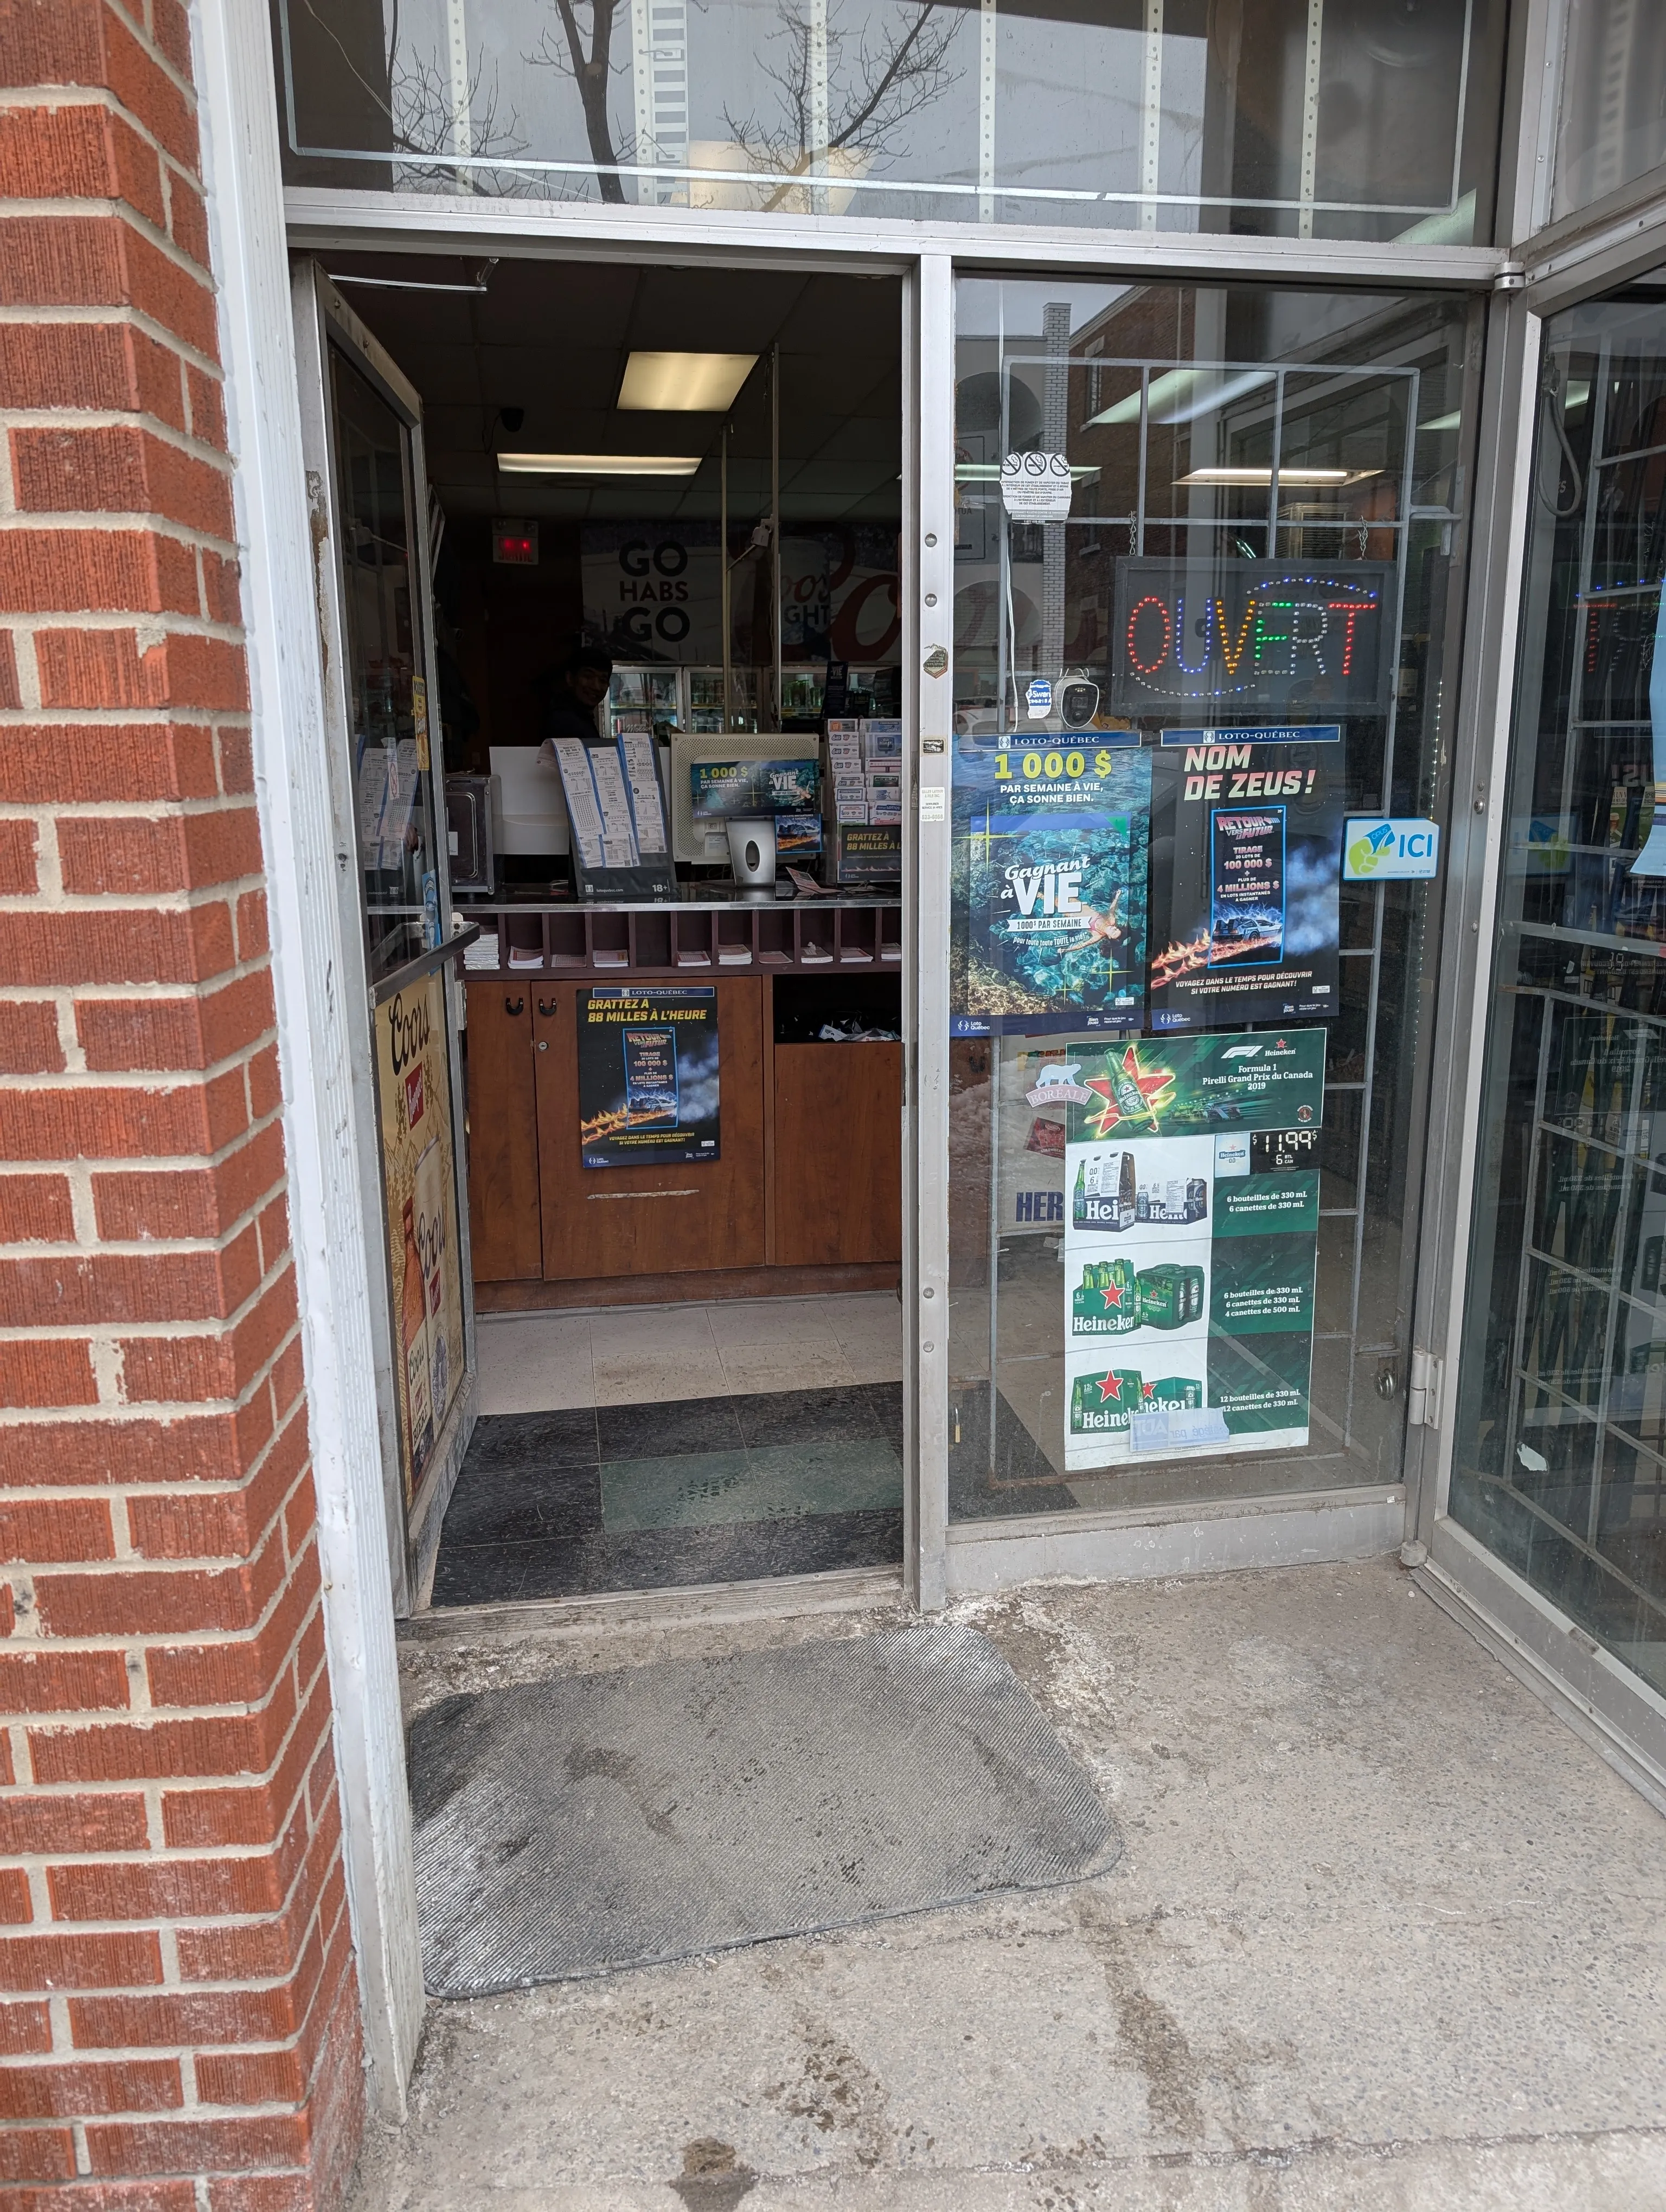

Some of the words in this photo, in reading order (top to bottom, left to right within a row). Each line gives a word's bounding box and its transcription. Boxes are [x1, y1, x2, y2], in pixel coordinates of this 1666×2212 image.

[619, 541, 688, 576] GO
[620, 581, 688, 601] HABS
[622, 607, 690, 642] GO
[1127, 596, 1377, 676] OUVERT
[1015, 736, 1099, 745] LOTO-QUÉBEC
[1219, 731, 1300, 740] LOTO-QUÉBEC
[995, 754, 1013, 779] 1
[1022, 751, 1085, 779] 000
[1094, 750, 1111, 779] $
[1184, 745, 1252, 771] NOM
[700, 768, 707, 779] 1
[712, 767, 736, 778] 000
[741, 766, 748, 777] $
[772, 775, 797, 790] VIE
[1001, 785, 1021, 793] PAR
[1023, 783, 1074, 793] SEMAINE
[1075, 781, 1082, 792] À
[1084, 782, 1104, 792] VIE,
[1184, 775, 1223, 800] DE
[1010, 796, 1026, 805] ÇA
[1027, 795, 1065, 803] SONNE
[1066, 794, 1094, 802] BIEN.
[1216, 816, 1266, 831] RETOUR
[883, 831, 889, 840] À
[1372, 826, 1388, 839] OPUS
[1233, 846, 1263, 854] TIRAGE
[1399, 834, 1432, 858] ICI
[1005, 856, 1090, 880] Gagnant
[1224, 860, 1241, 869] 100
[1244, 859, 1263, 868] 000
[1265, 858, 1272, 867] $
[1225, 882, 1270, 892] MILLIONS
[1273, 880, 1279, 889] $
[1001, 885, 1014, 899] à
[1013, 872, 1081, 915] VIE
[1053, 919, 1081, 928] SEMAINE
[1176, 979, 1204, 988] VOYAGEZ
[1277, 970, 1312, 980] DÉCOUVRIR
[1221, 983, 1249, 993] NUMÉRO
[588, 999, 639, 1009] GRATTEZ
[640, 997, 649, 1008] À
[588, 1012, 603, 1023] 88
[606, 1011, 648, 1021] MILLES
[650, 1008, 658, 1021] À
[661, 1009, 707, 1020] L'HEURE
[389, 992, 430, 1076] Coors
[1228, 1075, 1252, 1083] Grand
[1248, 1082, 1266, 1090] 2019
[1030, 1087, 1089, 1106] BORÉALE
[1276, 1154, 1283, 1165] 6
[1229, 1290, 1264, 1298] bouteilles
[1229, 1394, 1264, 1402] bouteilles
[1232, 1403, 1261, 1411] canettes
